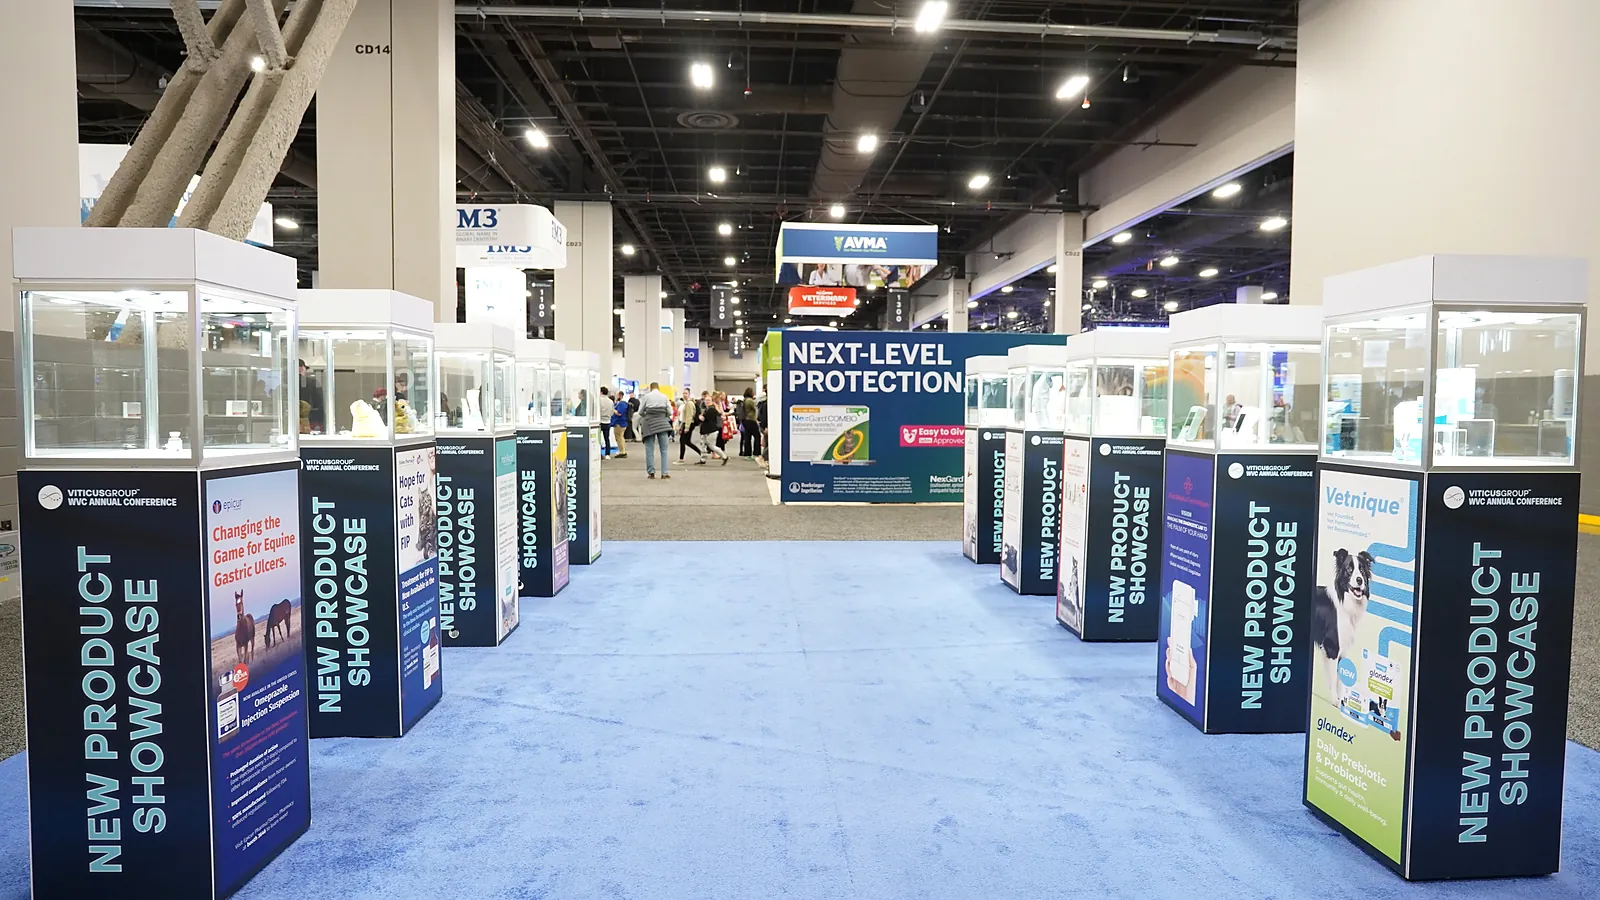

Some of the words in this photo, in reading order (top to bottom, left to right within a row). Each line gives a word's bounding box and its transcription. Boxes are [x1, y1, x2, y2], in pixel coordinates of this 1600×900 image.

[355, 44, 390, 54] CD14
[456, 208, 498, 228] M3
[844, 236, 887, 249] AVMA
[789, 342, 952, 365] NEXT-LEVEL
[919, 428, 939, 437] Easy
[400, 475, 415, 490] Hope
[417, 471, 425, 484] for
[567, 459, 577, 542] SHOWCASE
[993, 450, 1005, 517] PRODUCT
[1041, 457, 1057, 537] PRODUCT
[68, 498, 86, 506] WVC
[88, 498, 125, 506] ANNUAL
[126, 498, 177, 506] CONFERENCE
[400, 496, 413, 509] Cats
[400, 513, 414, 529] with
[522, 470, 537, 569] SHOWCASE
[1110, 472, 1130, 570] PRODUCT
[213, 519, 262, 541] Changing
[264, 516, 280, 530] the
[401, 535, 410, 550] FIP
[436, 473, 454, 576] PRODUCT
[993, 520, 1002, 552] NEW
[214, 546, 244, 564] Game
[247, 541, 262, 555] for
[264, 532, 295, 552] Equine
[457, 488, 476, 611] SHOWCASE
[1039, 539, 1054, 580] NEW
[1129, 487, 1150, 605] SHOWCASE
[214, 563, 252, 587] Gastric
[255, 557, 286, 574] Ulcers.
[312, 497, 338, 637] PRODUCT
[1244, 501, 1270, 637] PRODUCT
[344, 519, 371, 686] SHOWCASE
[439, 582, 454, 630] NEW
[1108, 576, 1125, 623] NEW
[1270, 522, 1297, 684] SHOWCASE
[77, 546, 118, 760] PRODUCT
[1464, 542, 1502, 739] PRODUCT
[316, 646, 341, 712] NEW
[1241, 645, 1264, 709] NEW
[1340, 668, 1355, 679] new
[1369, 670, 1393, 684] glandex
[1499, 572, 1540, 806] SHOWCASE
[124, 579, 167, 833] SHOWCASE
[242, 707, 268, 727] Injection
[269, 690, 300, 712] Suspension
[254, 684, 288, 707] Omeprazole
[1317, 718, 1354, 744] glandex
[230, 762, 248, 778] Prolonged
[249, 754, 263, 765] duration
[268, 744, 278, 753] action
[1316, 752, 1322, 763] &
[1325, 756, 1368, 791] Probiotic
[1316, 767, 1337, 785] Supports
[1338, 780, 1347, 790] gut
[1317, 738, 1339, 760] Daily
[1342, 753, 1387, 787] Prebiotic
[231, 791, 248, 807] Improved
[249, 778, 267, 794] compliance
[1343, 794, 1356, 807] daily
[1458, 752, 1491, 844] NEW
[86, 772, 122, 872] NEW
